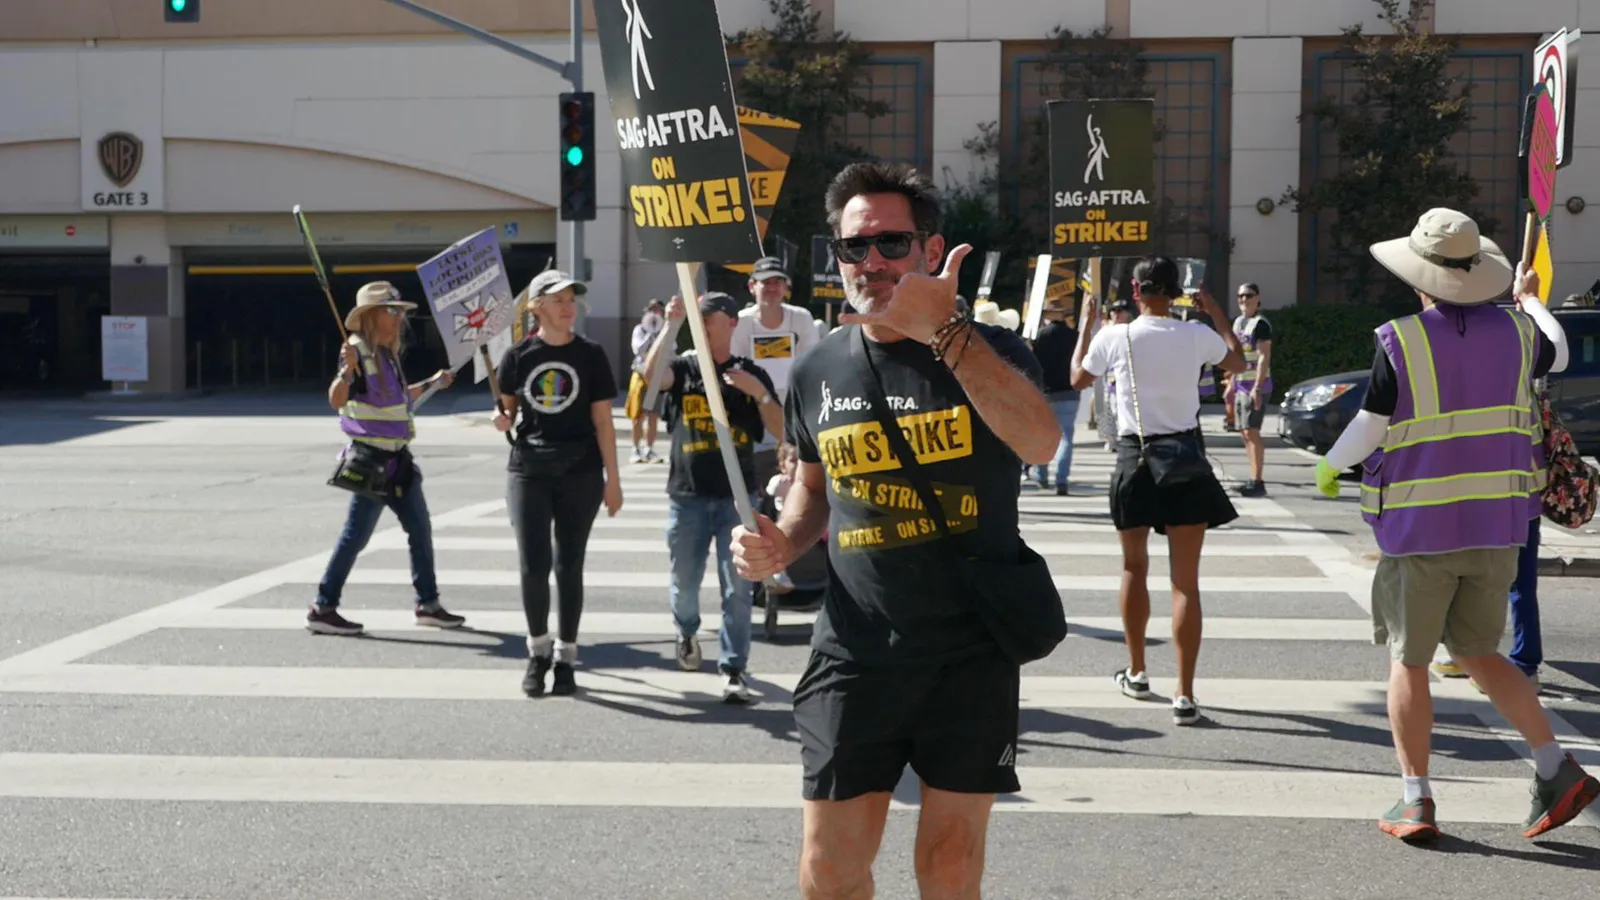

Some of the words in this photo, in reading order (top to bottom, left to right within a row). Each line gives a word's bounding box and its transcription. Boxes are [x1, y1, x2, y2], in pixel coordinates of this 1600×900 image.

[652, 156, 676, 180] ON
[93, 192, 135, 206] GATE
[140, 192, 149, 206] 3
[630, 177, 745, 228] STRIKE!
[1085, 208, 1106, 221] ON
[1054, 221, 1149, 244] STRIKE!
[825, 433, 857, 470] ON
[897, 519, 918, 539] ON
